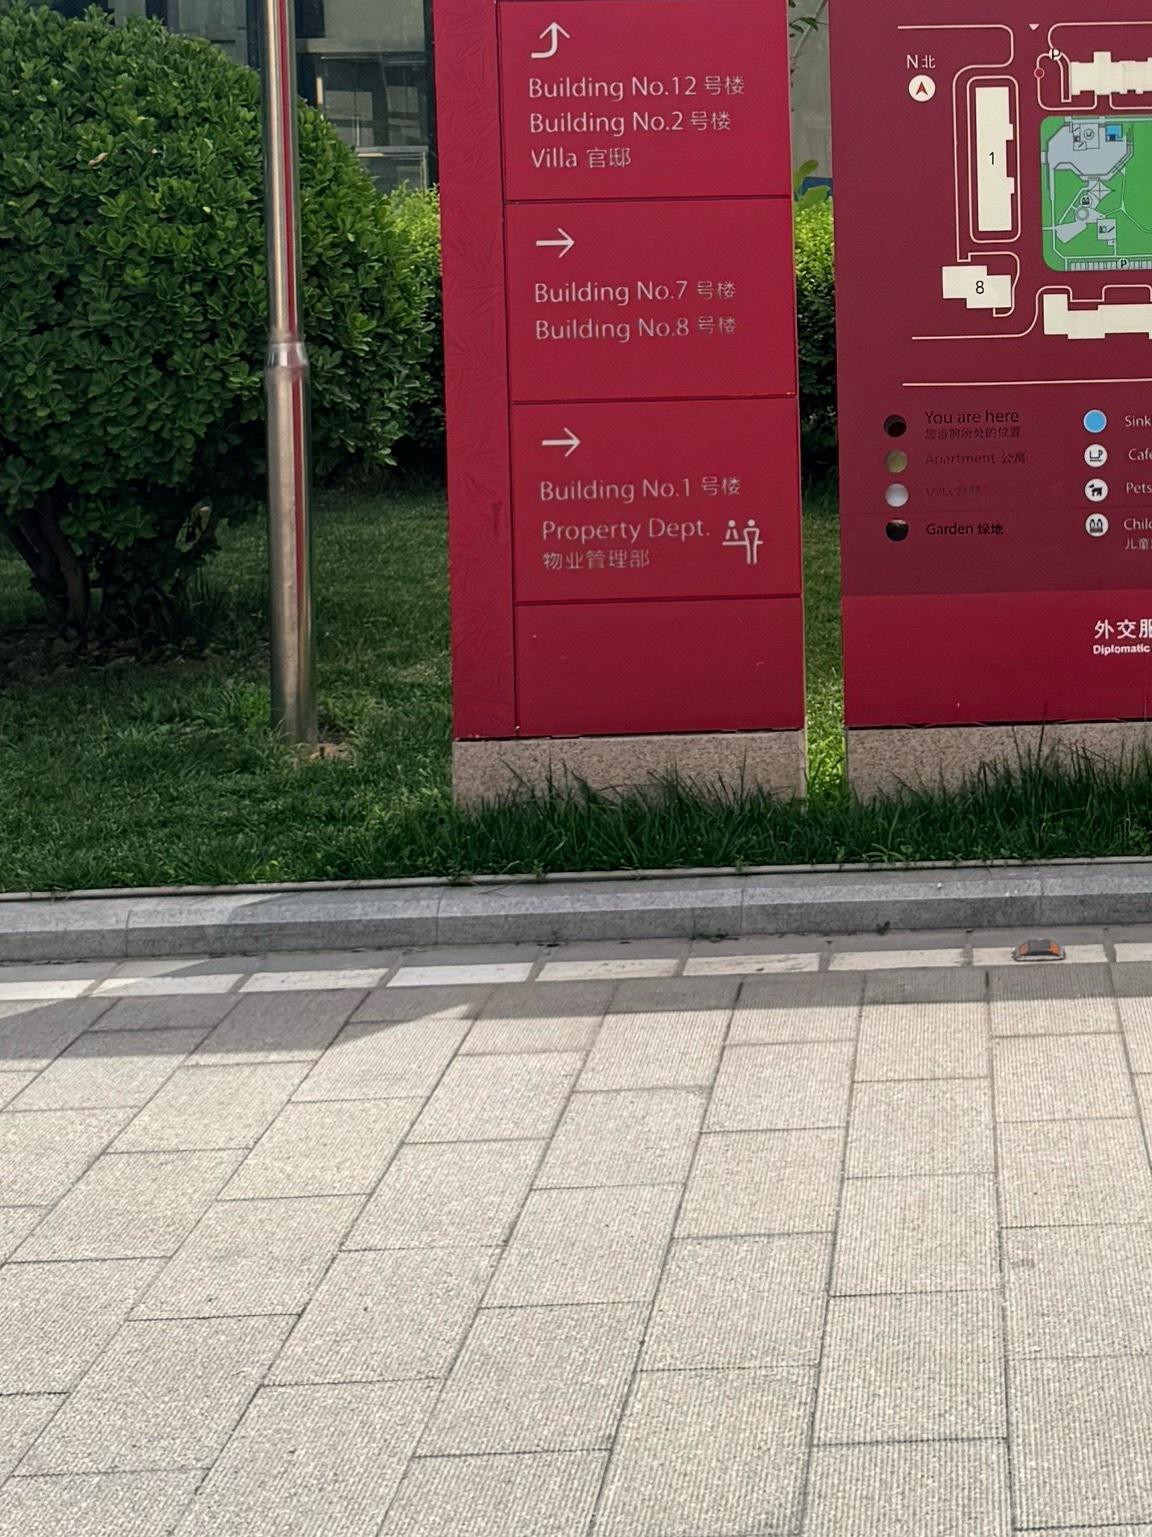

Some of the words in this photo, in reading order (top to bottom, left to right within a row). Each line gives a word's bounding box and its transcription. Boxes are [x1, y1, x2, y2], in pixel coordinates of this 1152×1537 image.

[906, 54, 919, 69] N
[529, 77, 624, 102] Building
[632, 75, 697, 96] No.12
[703, 75, 745, 96] 号楼
[530, 112, 625, 137] Building
[632, 111, 684, 132] No.2
[689, 110, 731, 131] 号楼
[531, 147, 578, 168] Villa
[586, 147, 631, 169] 官邸
[988, 151, 996, 165] 1
[534, 282, 629, 306] Building
[636, 281, 688, 301] No.7
[696, 280, 736, 299] 号楼
[974, 280, 986, 295] 8
[536, 319, 630, 343] Building
[638, 317, 689, 338] No.8
[698, 316, 736, 336] 号楼
[925, 410, 953, 425] You
[957, 412, 981, 424] are
[985, 410, 1019, 424] here
[925, 452, 996, 466] Apartment
[540, 480, 635, 504] Building
[642, 478, 690, 498] No.1
[701, 476, 742, 496] 号楼
[542, 519, 642, 544] Property
[649, 517, 710, 541] Dept.
[926, 522, 974, 536] Garden
[542, 549, 650, 570] 物业管理部
[1093, 643, 1151, 656] Diplomatic
